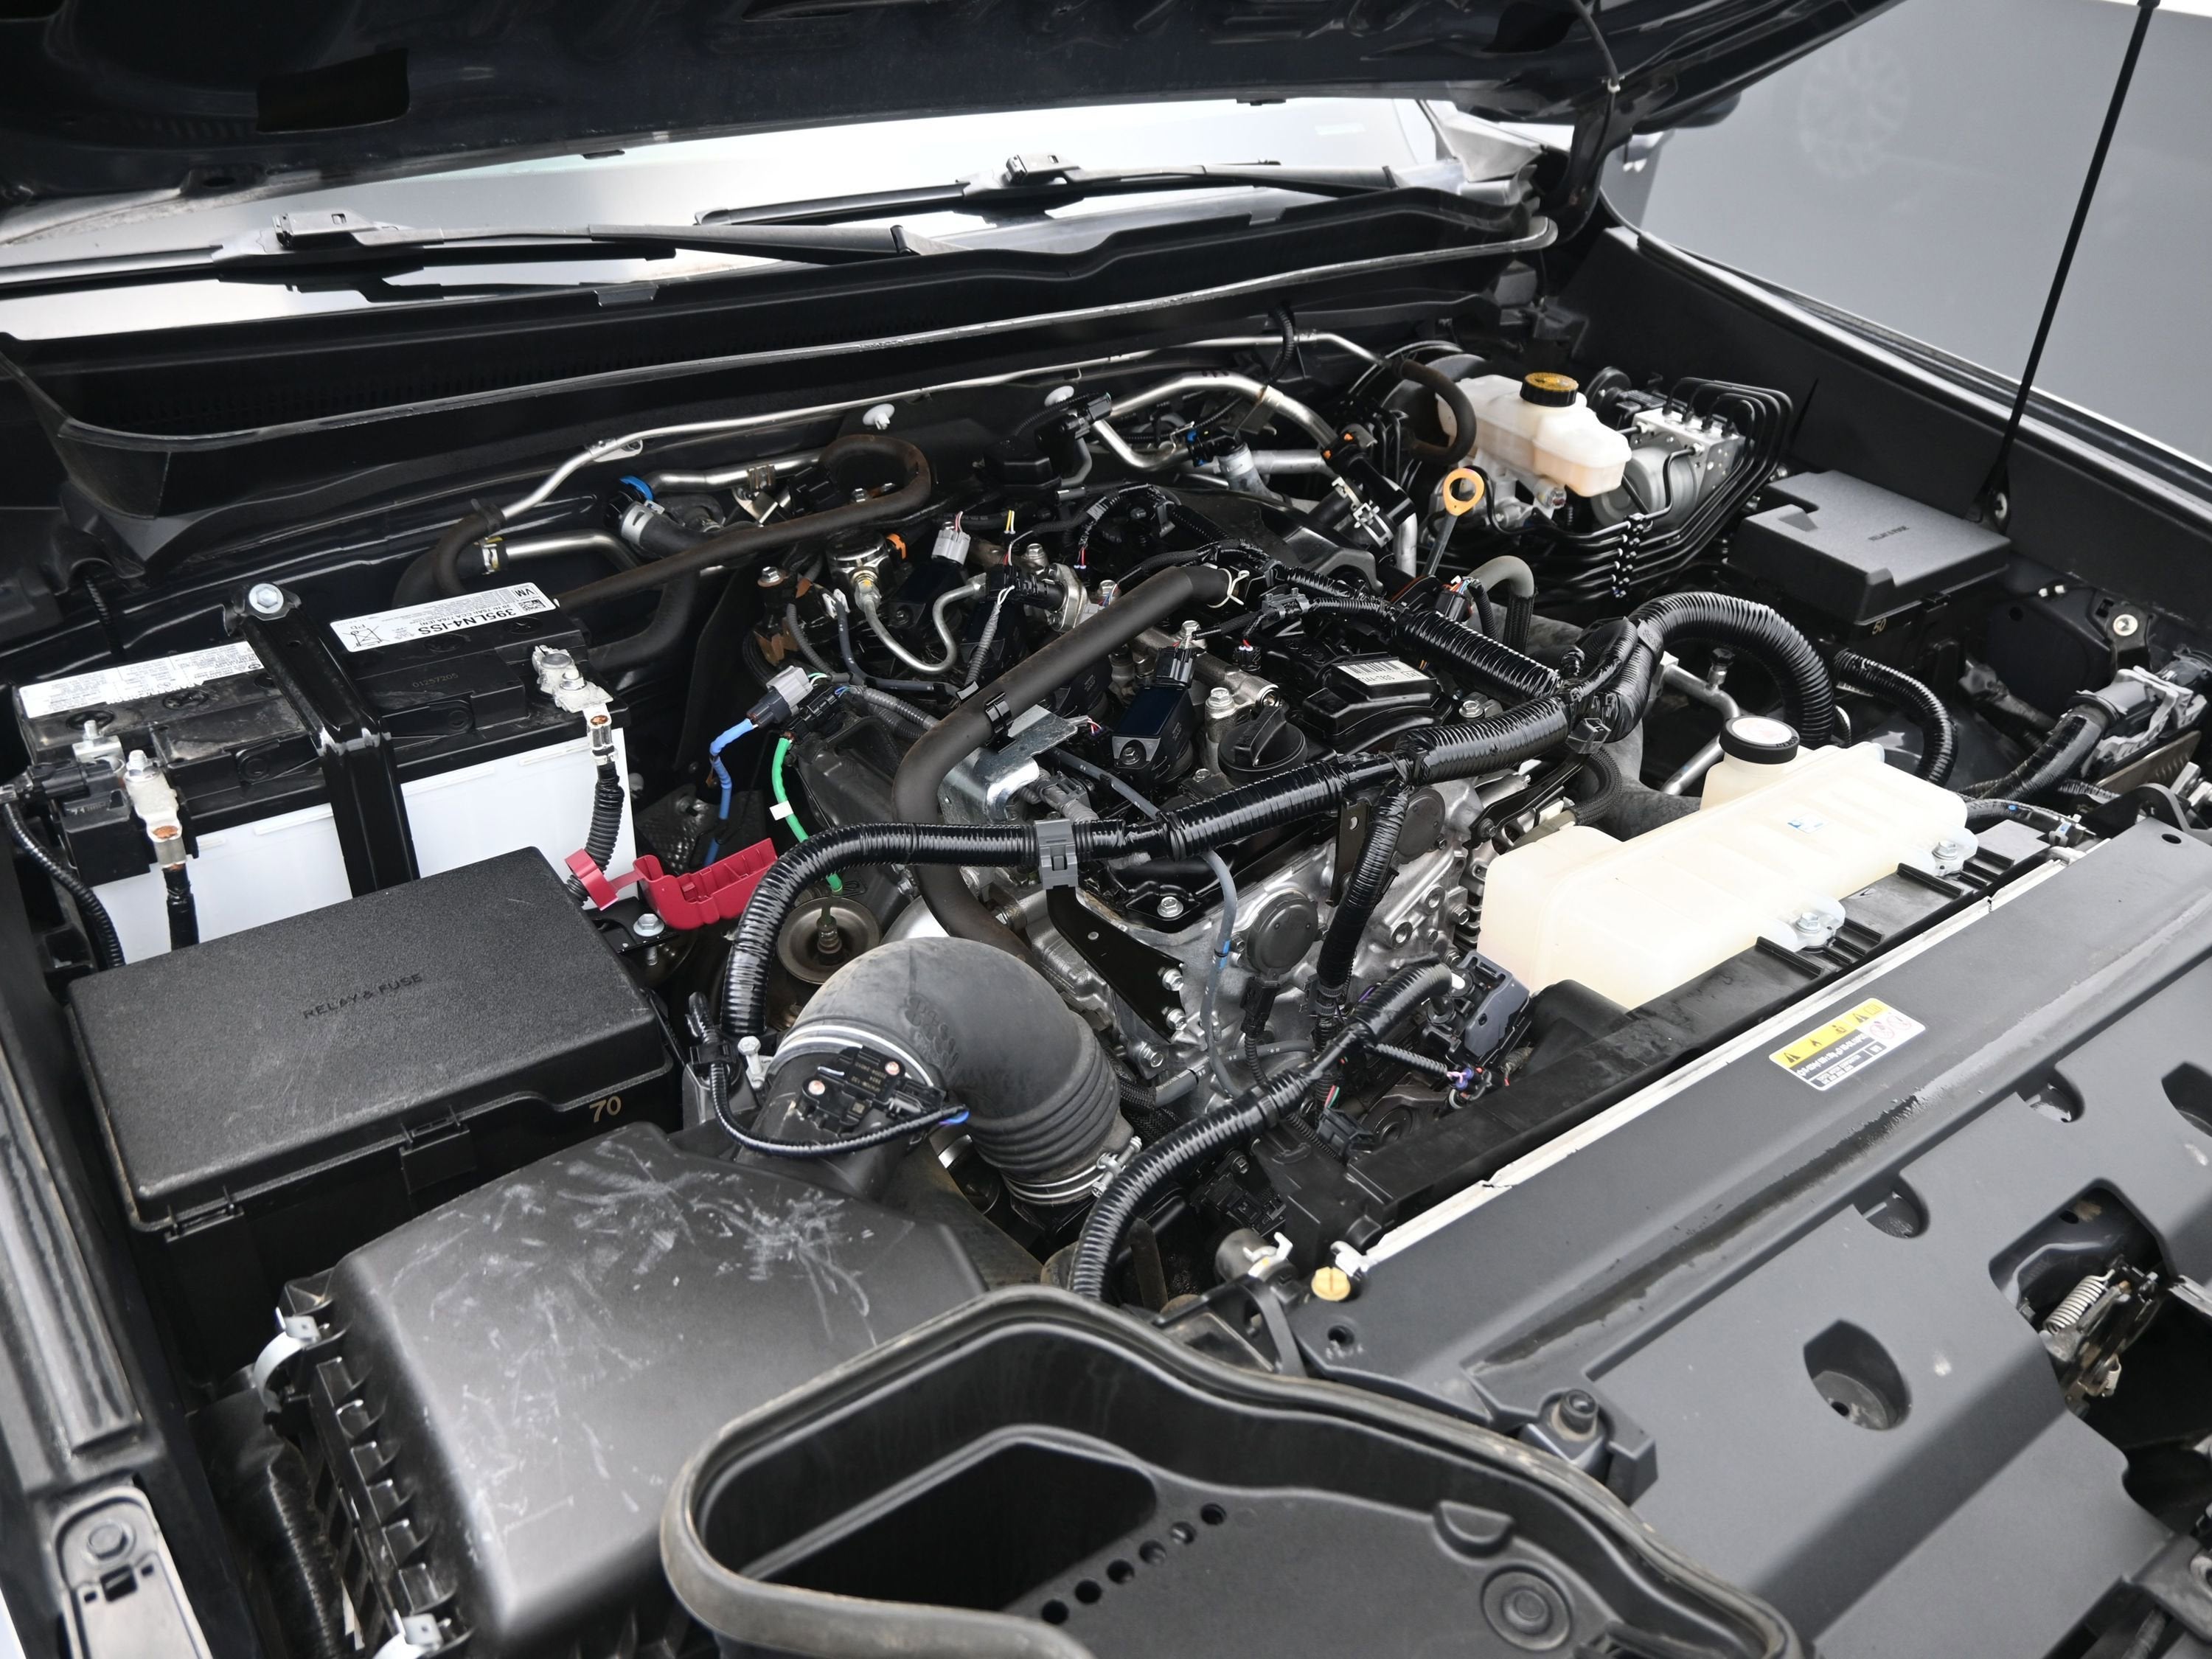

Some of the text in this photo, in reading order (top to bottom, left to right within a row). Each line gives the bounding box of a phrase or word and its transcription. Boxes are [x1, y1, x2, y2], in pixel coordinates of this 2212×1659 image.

[514, 588, 535, 597] VM
[417, 608, 516, 635] 395LN4-ISS
[1872, 618, 1887, 635] 50
[303, 994, 357, 1019] RELAY
[378, 973, 422, 993] FUSE
[589, 1096, 622, 1123] 70
